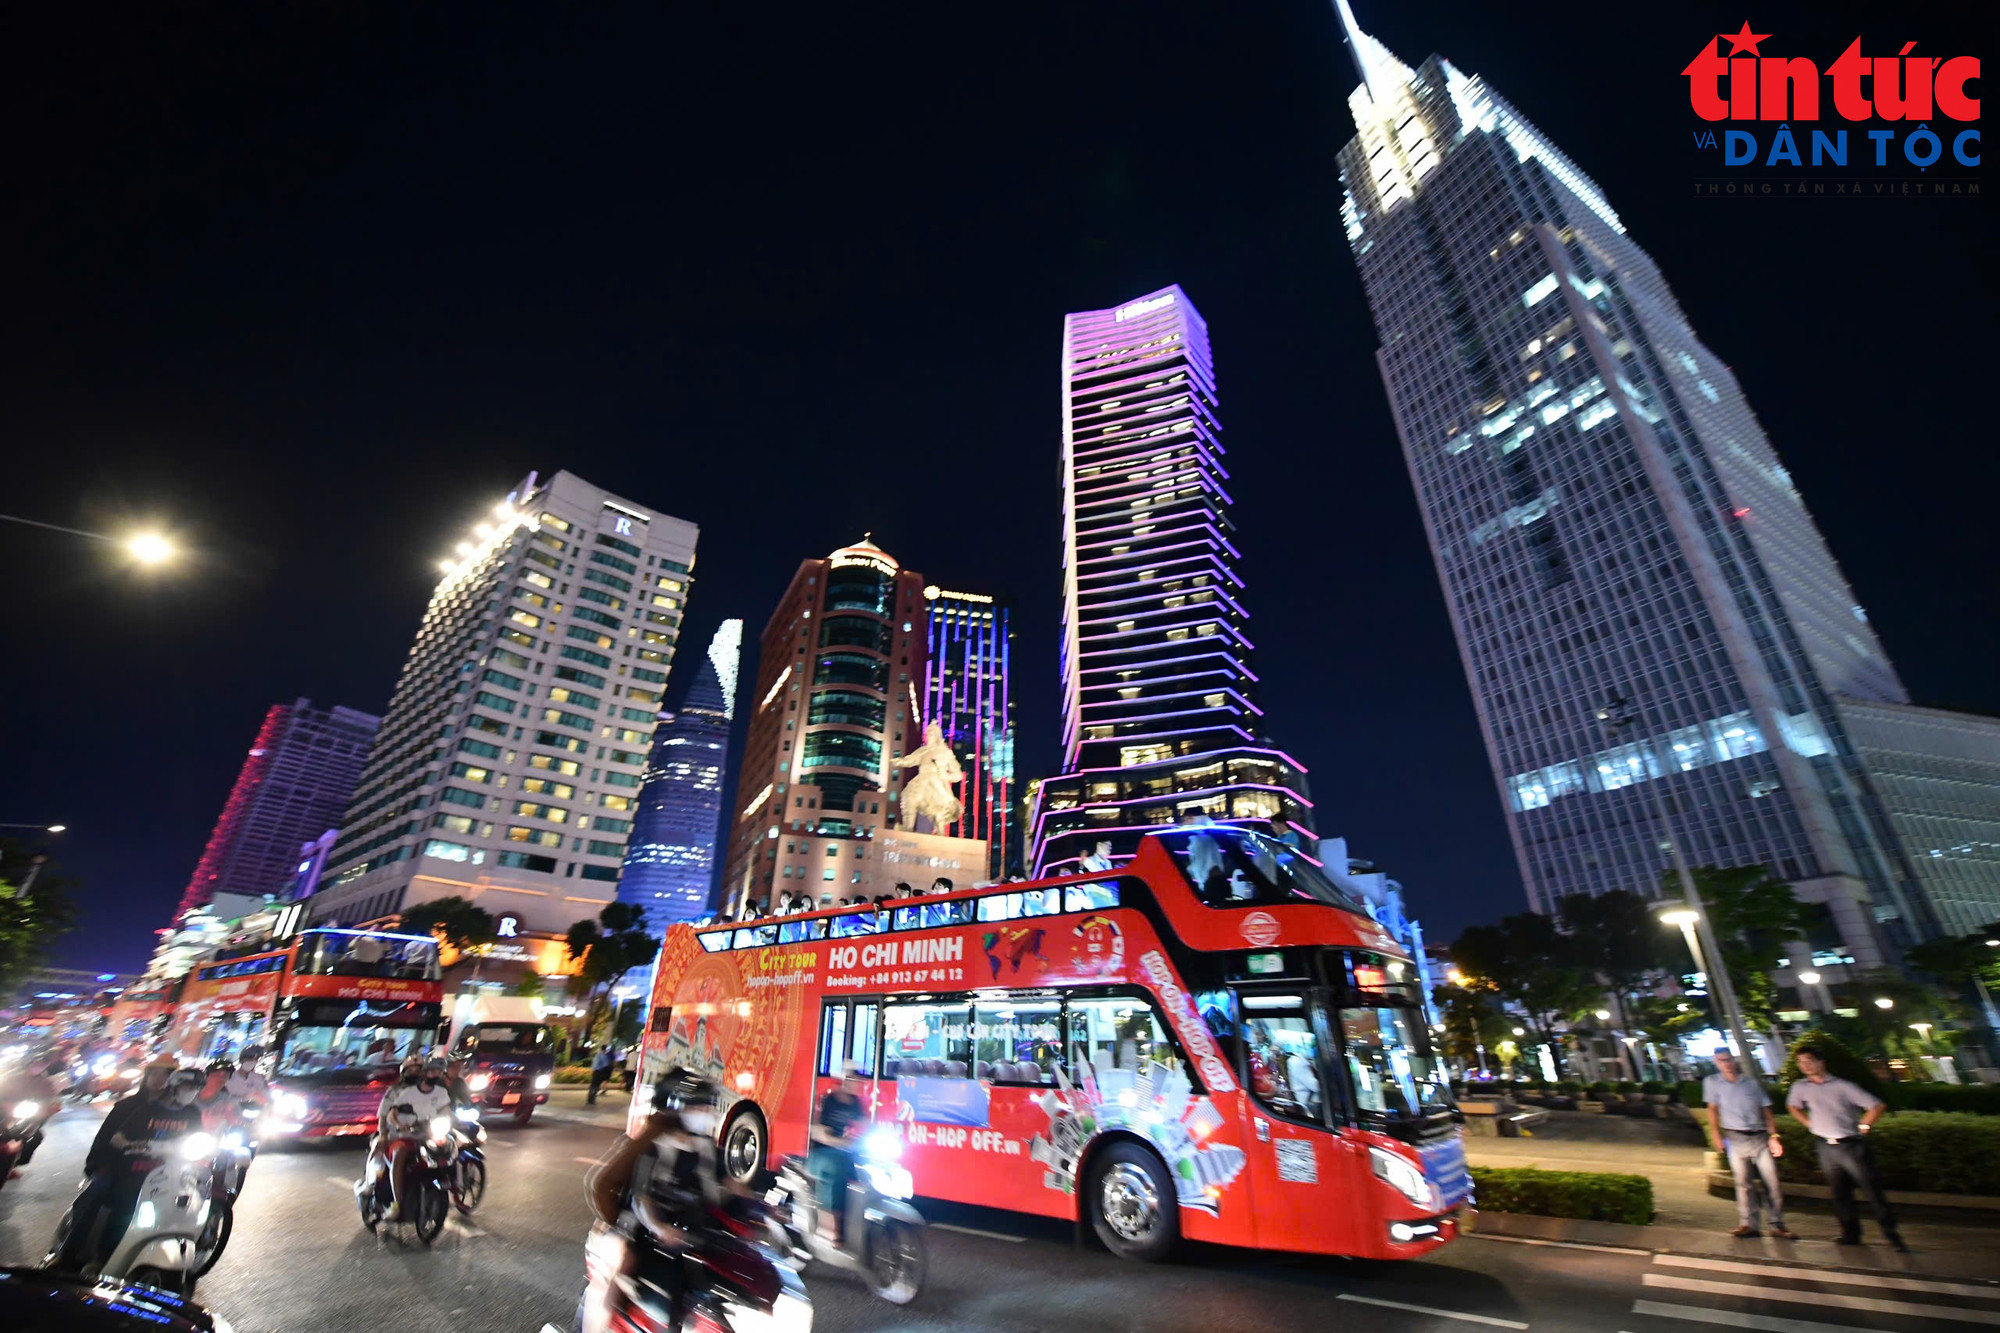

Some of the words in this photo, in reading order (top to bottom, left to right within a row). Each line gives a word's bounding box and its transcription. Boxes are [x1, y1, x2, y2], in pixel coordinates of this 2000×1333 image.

[614, 517, 632, 536] R
[497, 917, 518, 938] R
[829, 947, 858, 970] HO
[861, 942, 899, 967] CHI
[902, 936, 964, 965] MINH
[746, 970, 815, 989] hopon-hopoff.vn
[826, 973, 867, 989] Booking:
[869, 971, 890, 986] +84
[891, 971, 912, 985] 913
[914, 970, 929, 983] 67
[930, 969, 945, 982] 44
[948, 967, 964, 981] 12
[337, 987, 361, 998] HO
[361, 988, 388, 1000] CHI
[388, 990, 424, 1002] MINH
